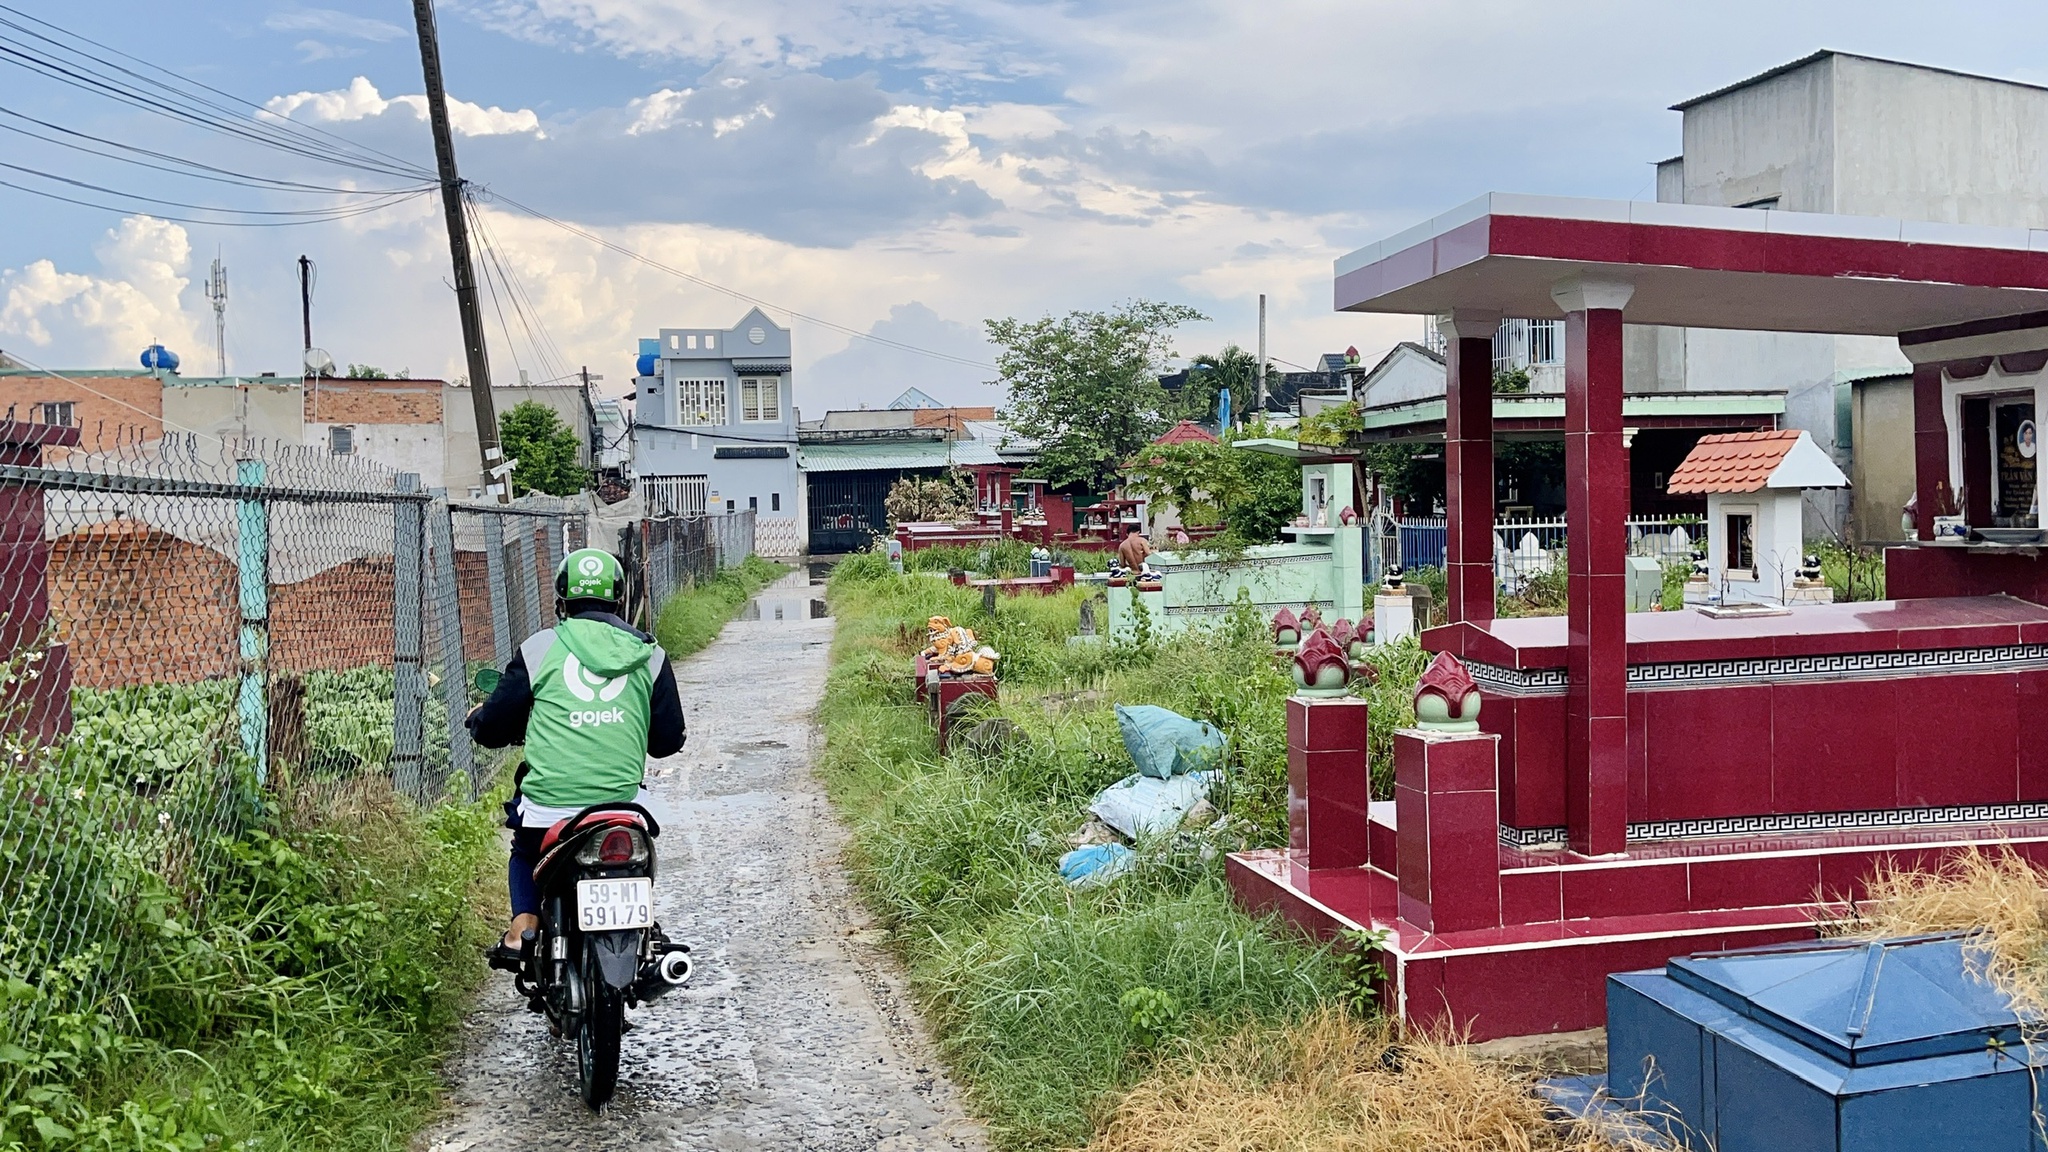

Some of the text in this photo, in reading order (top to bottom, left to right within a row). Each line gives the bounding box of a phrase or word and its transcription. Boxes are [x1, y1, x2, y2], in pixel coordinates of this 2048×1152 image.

[579, 578, 602, 587] gojek
[569, 706, 625, 728] gojek
[583, 904, 648, 926] 591.79
